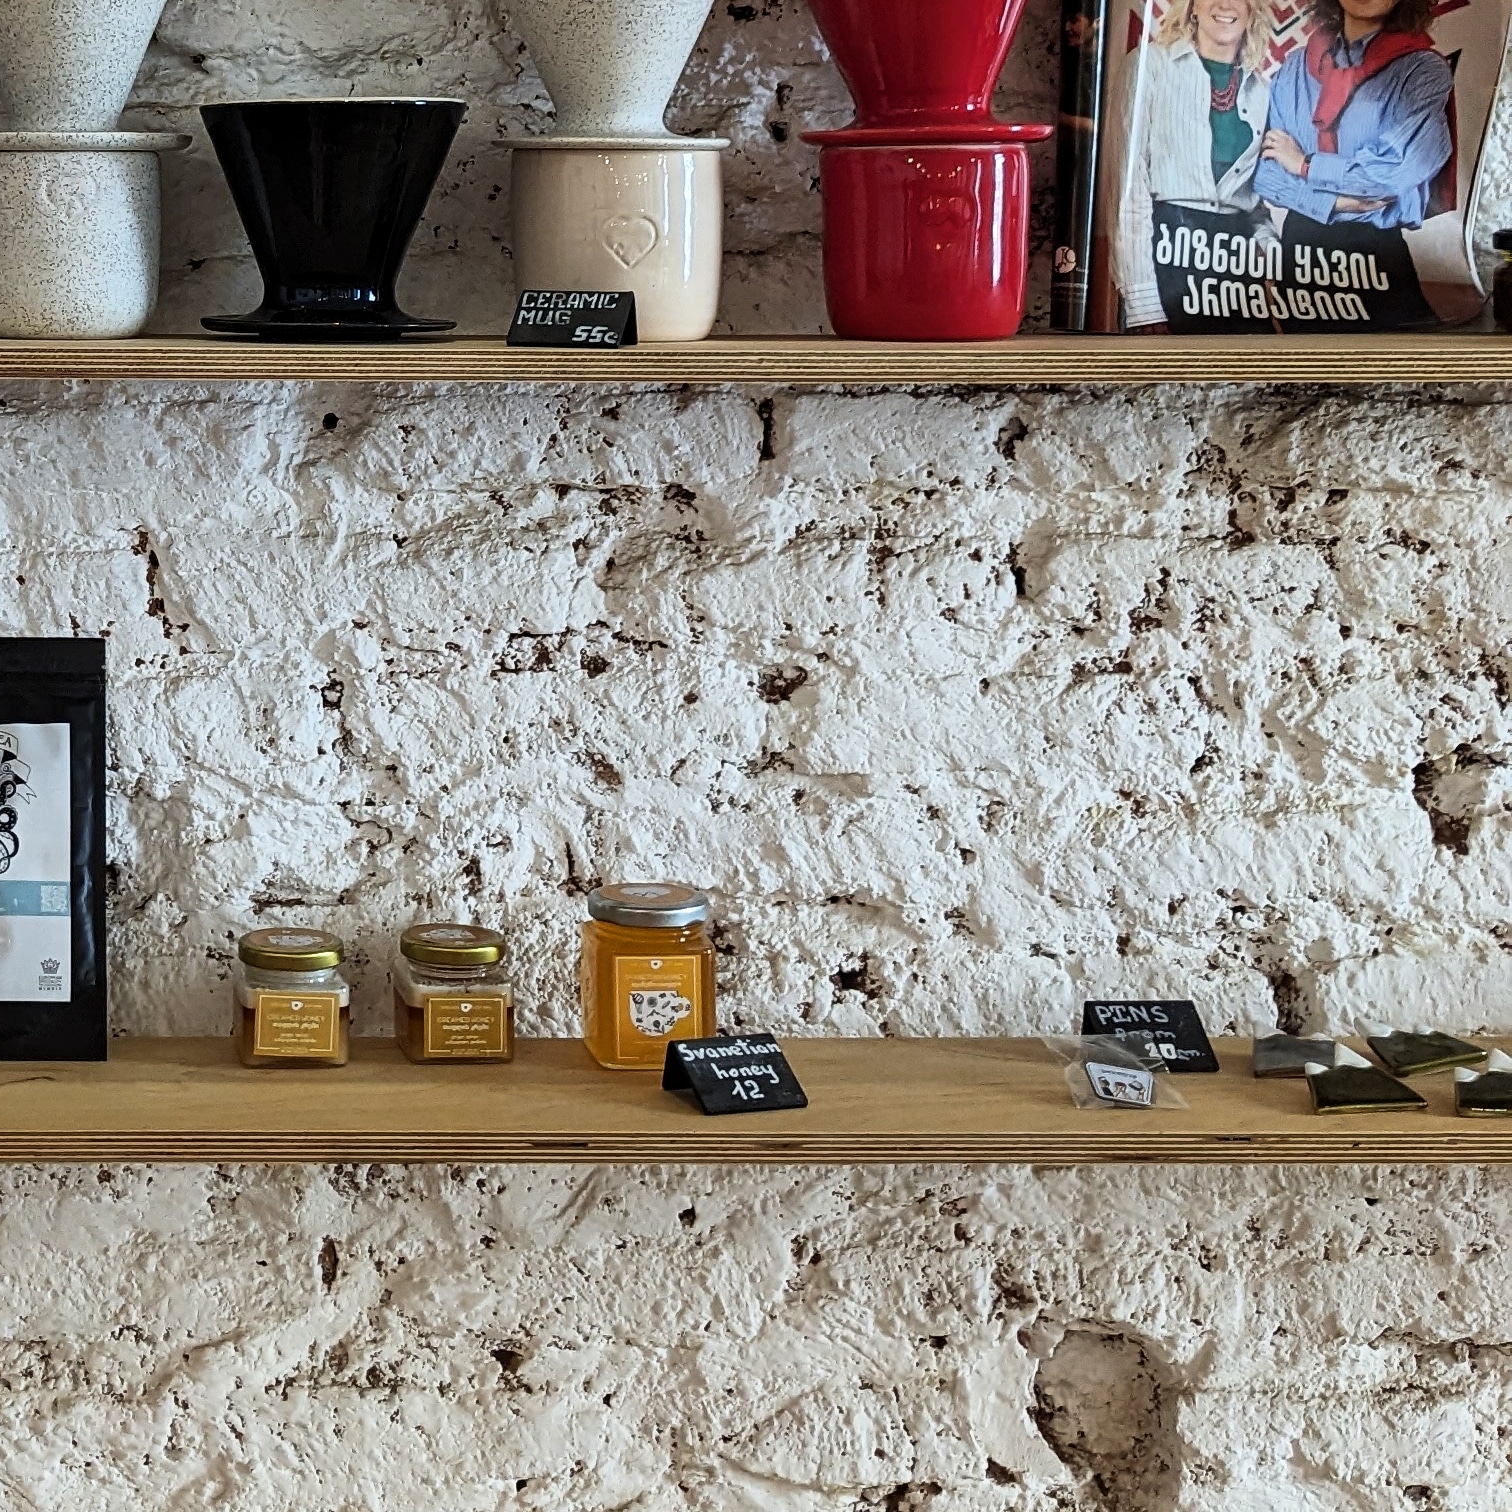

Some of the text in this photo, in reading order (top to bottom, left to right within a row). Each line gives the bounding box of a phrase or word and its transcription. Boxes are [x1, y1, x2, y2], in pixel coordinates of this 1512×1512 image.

[1156, 223, 1390, 291] ბიზნესი ყავის
[521, 291, 620, 309] CERAMIC
[516, 309, 572, 326] MUG
[1094, 1005, 1169, 1025] PINS
[677, 1038, 782, 1062] Svanetian
[710, 1062, 780, 1084] honey
[731, 1079, 765, 1101] 12
